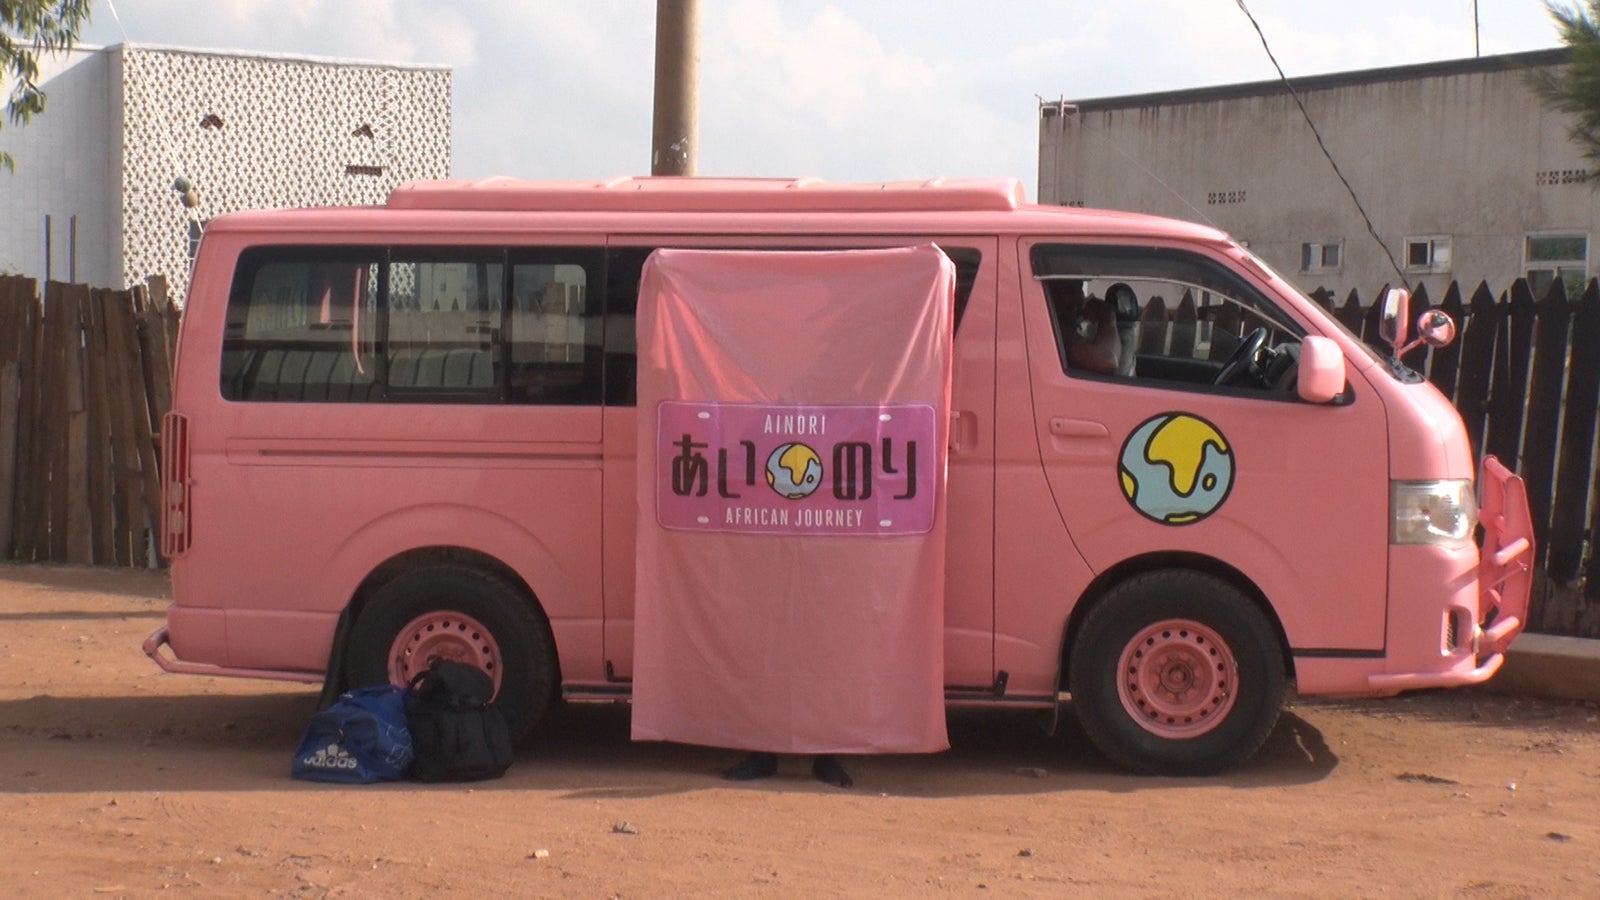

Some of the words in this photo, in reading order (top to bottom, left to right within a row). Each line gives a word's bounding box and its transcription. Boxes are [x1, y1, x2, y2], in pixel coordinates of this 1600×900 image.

[764, 414, 826, 435] AINORI
[725, 507, 788, 526] AFRICAN
[795, 508, 863, 528] JOURNEY
